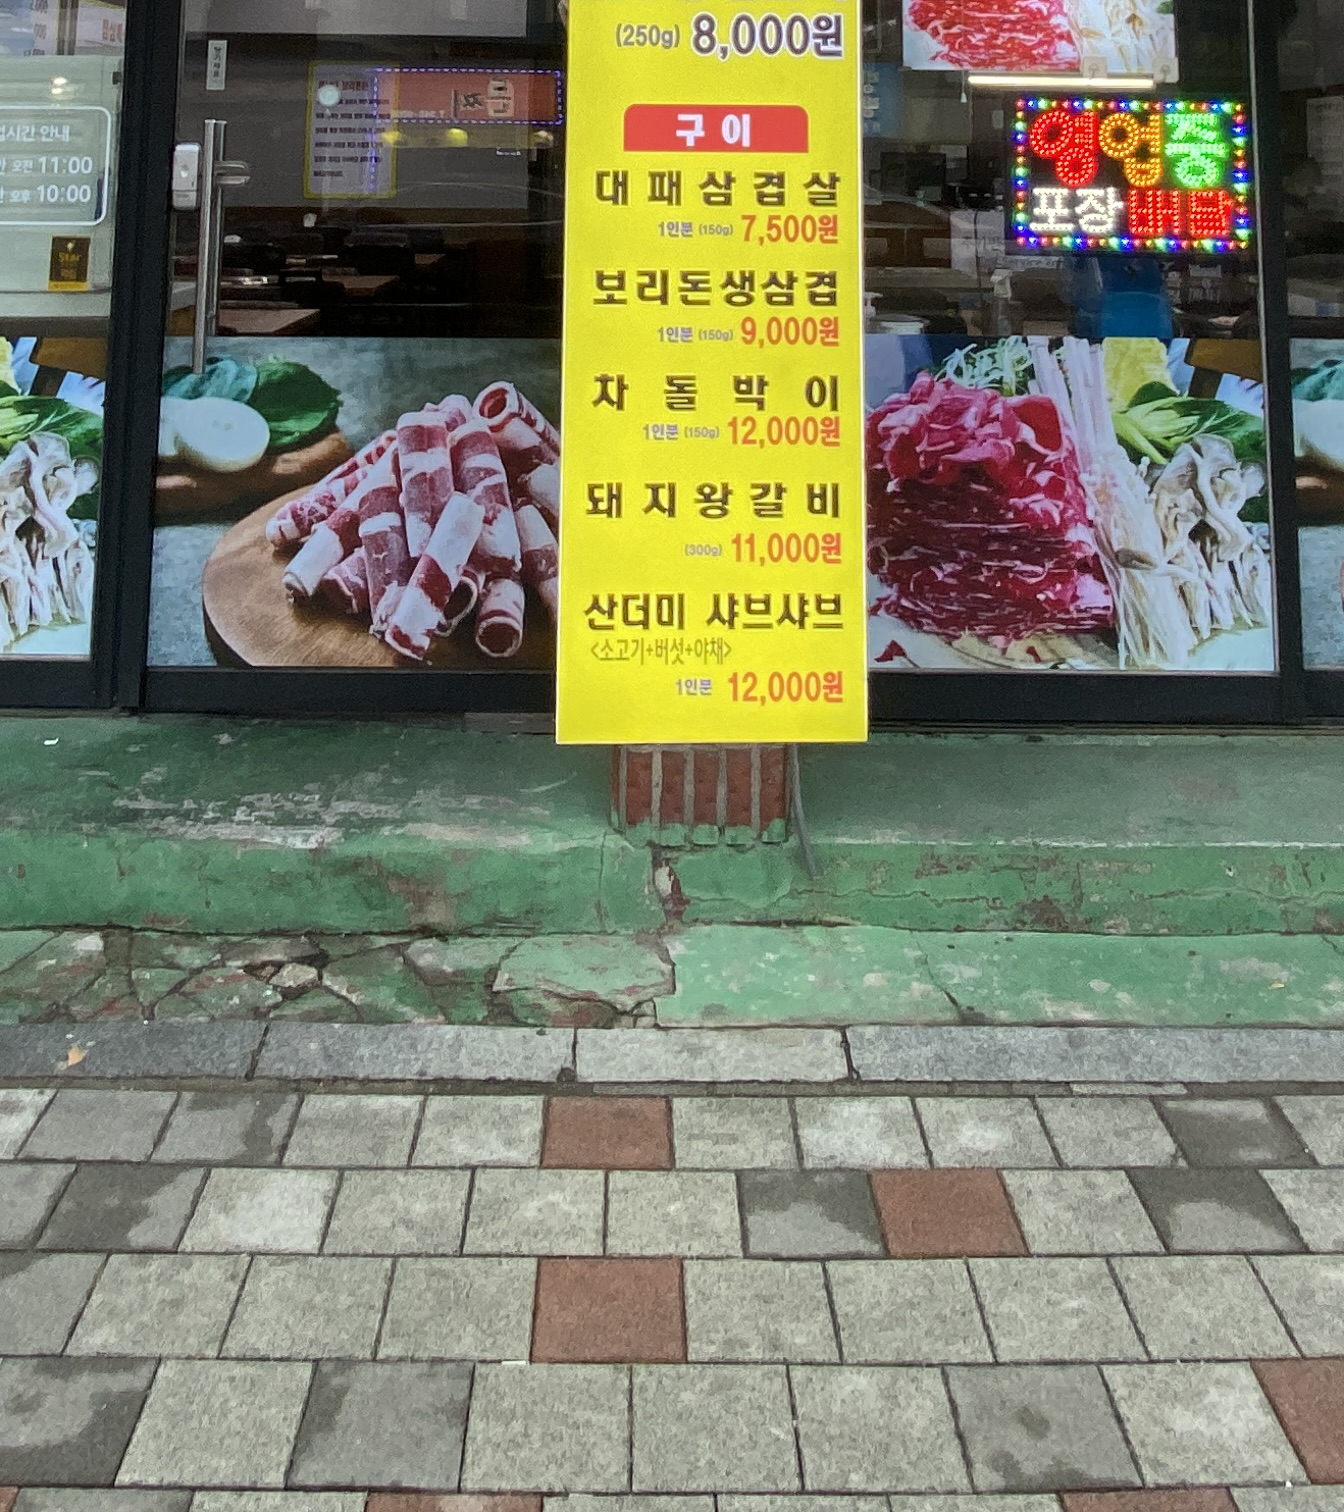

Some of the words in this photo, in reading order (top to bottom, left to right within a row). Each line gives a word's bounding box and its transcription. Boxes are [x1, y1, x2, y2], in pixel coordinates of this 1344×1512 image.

[616, 23, 680, 49] (250g)
[690, 12, 844, 61] 8,000원
[40, 123, 71, 143] 안내
[676, 113, 751, 148] 구이
[38, 155, 93, 175] 11:00
[1029, 110, 1227, 188] 영업중
[36, 184, 92, 203] 10:00
[595, 170, 840, 207] 대패삼겹살
[658, 222, 694, 237] 1인분
[699, 223, 733, 237] (150g)
[741, 214, 839, 245] 7,500원
[1029, 186, 1124, 234] 포장
[1128, 187, 1233, 238] 배달
[593, 269, 838, 306] 보리돈생삼겹
[658, 327, 694, 342] 1인분
[699, 328, 733, 342] (150g)
[740, 316, 839, 348] 9,000원
[592, 374, 839, 411] 차돌박이
[643, 424, 679, 440] 1인분
[685, 426, 720, 440] (150g)
[727, 416, 840, 448] 12,000원
[586, 482, 840, 518] 돼지왕갈비
[731, 533, 841, 565] 11,000원
[584, 593, 685, 630] 산더미
[706, 593, 844, 630] 샤브샤브
[676, 678, 712, 696] 1인분
[728, 671, 844, 706] 12,000원
